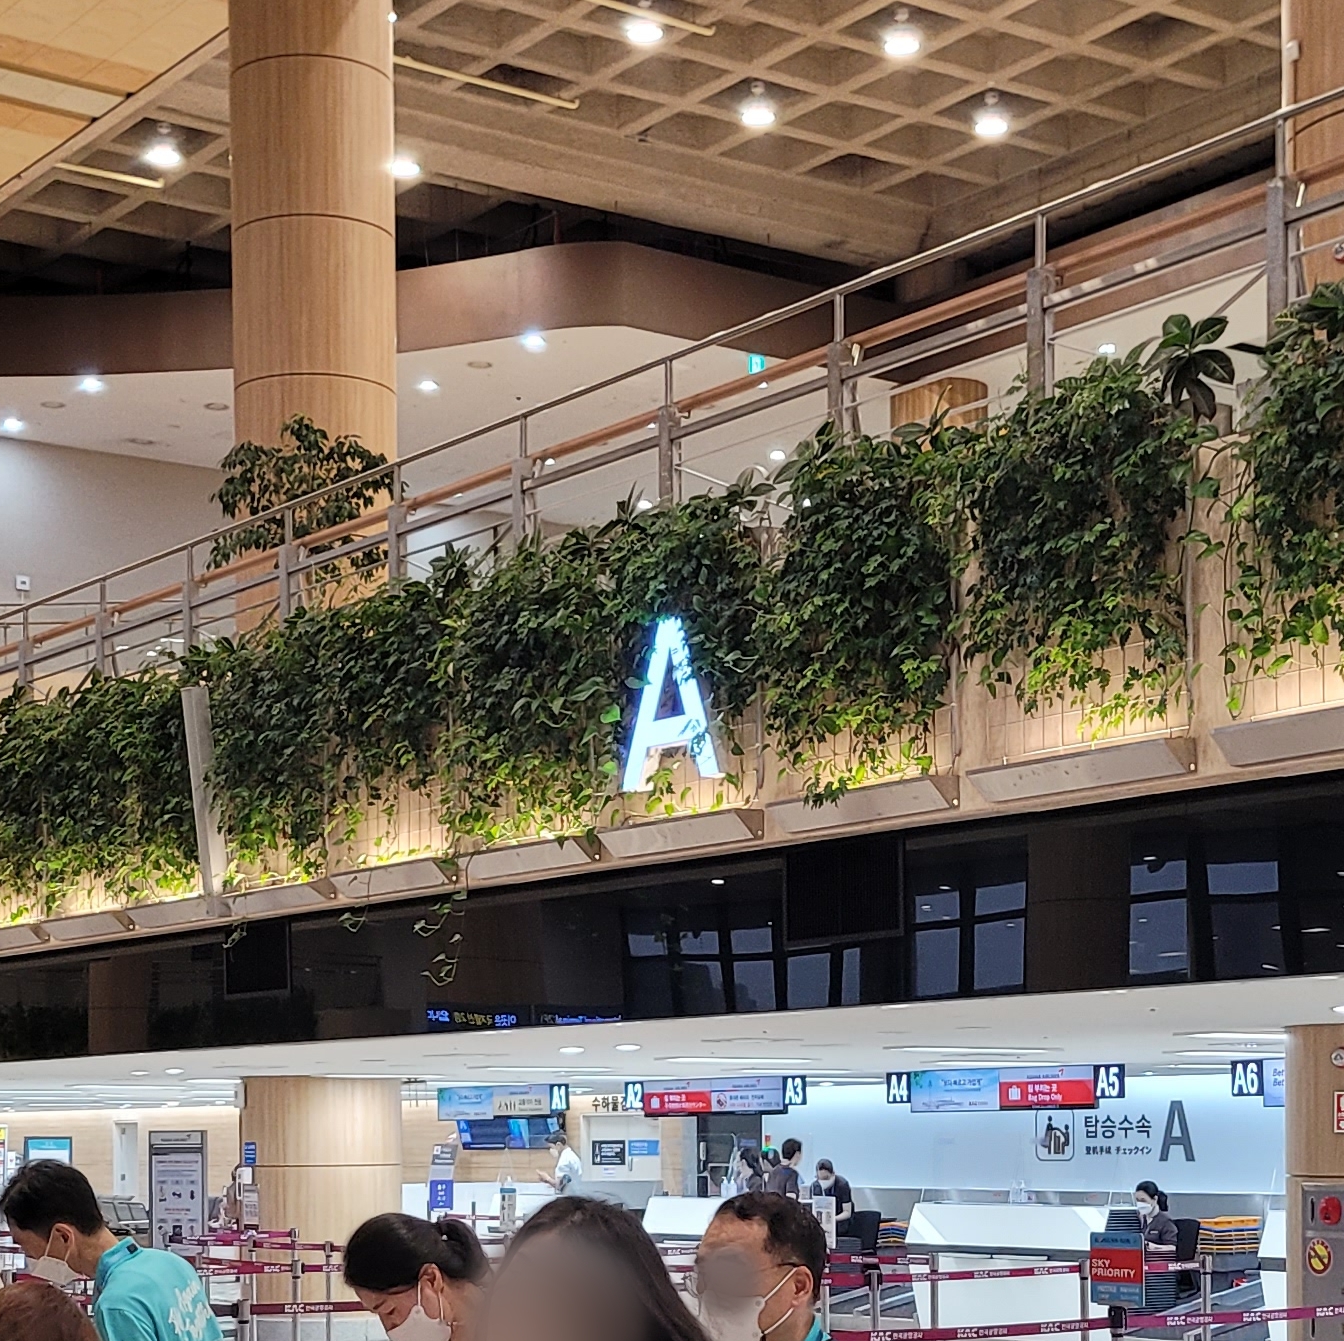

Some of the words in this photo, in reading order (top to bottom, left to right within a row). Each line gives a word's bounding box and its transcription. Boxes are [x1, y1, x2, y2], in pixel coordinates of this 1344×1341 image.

[623, 616, 720, 793] A
[1096, 1067, 1119, 1096] A5
[1233, 1064, 1258, 1094] A6
[786, 1078, 802, 1104] A3
[889, 1075, 908, 1101] A4
[551, 1086, 567, 1110] A1
[626, 1084, 643, 1110] A2
[1028, 1093, 1037, 1102] Bag
[1038, 1093, 1050, 1102] Drop
[1051, 1093, 1062, 1102] Only
[1084, 1114, 1152, 1139] 탑승수속
[1158, 1100, 1196, 1162] A
[1115, 1146, 1152, 1155] チェックイン
[1092, 1259, 1110, 1267] SKY
[1092, 1269, 1135, 1278] PRIORITY
[285, 1304, 304, 1313] KAC
[1316, 1306, 1334, 1316] KAC
[1167, 1316, 1186, 1326] KAC
[1243, 1312, 1261, 1322] KAC
[1041, 1322, 1060, 1332] KAC
[871, 1330, 892, 1341] KAC
[957, 1328, 978, 1338] KAC
